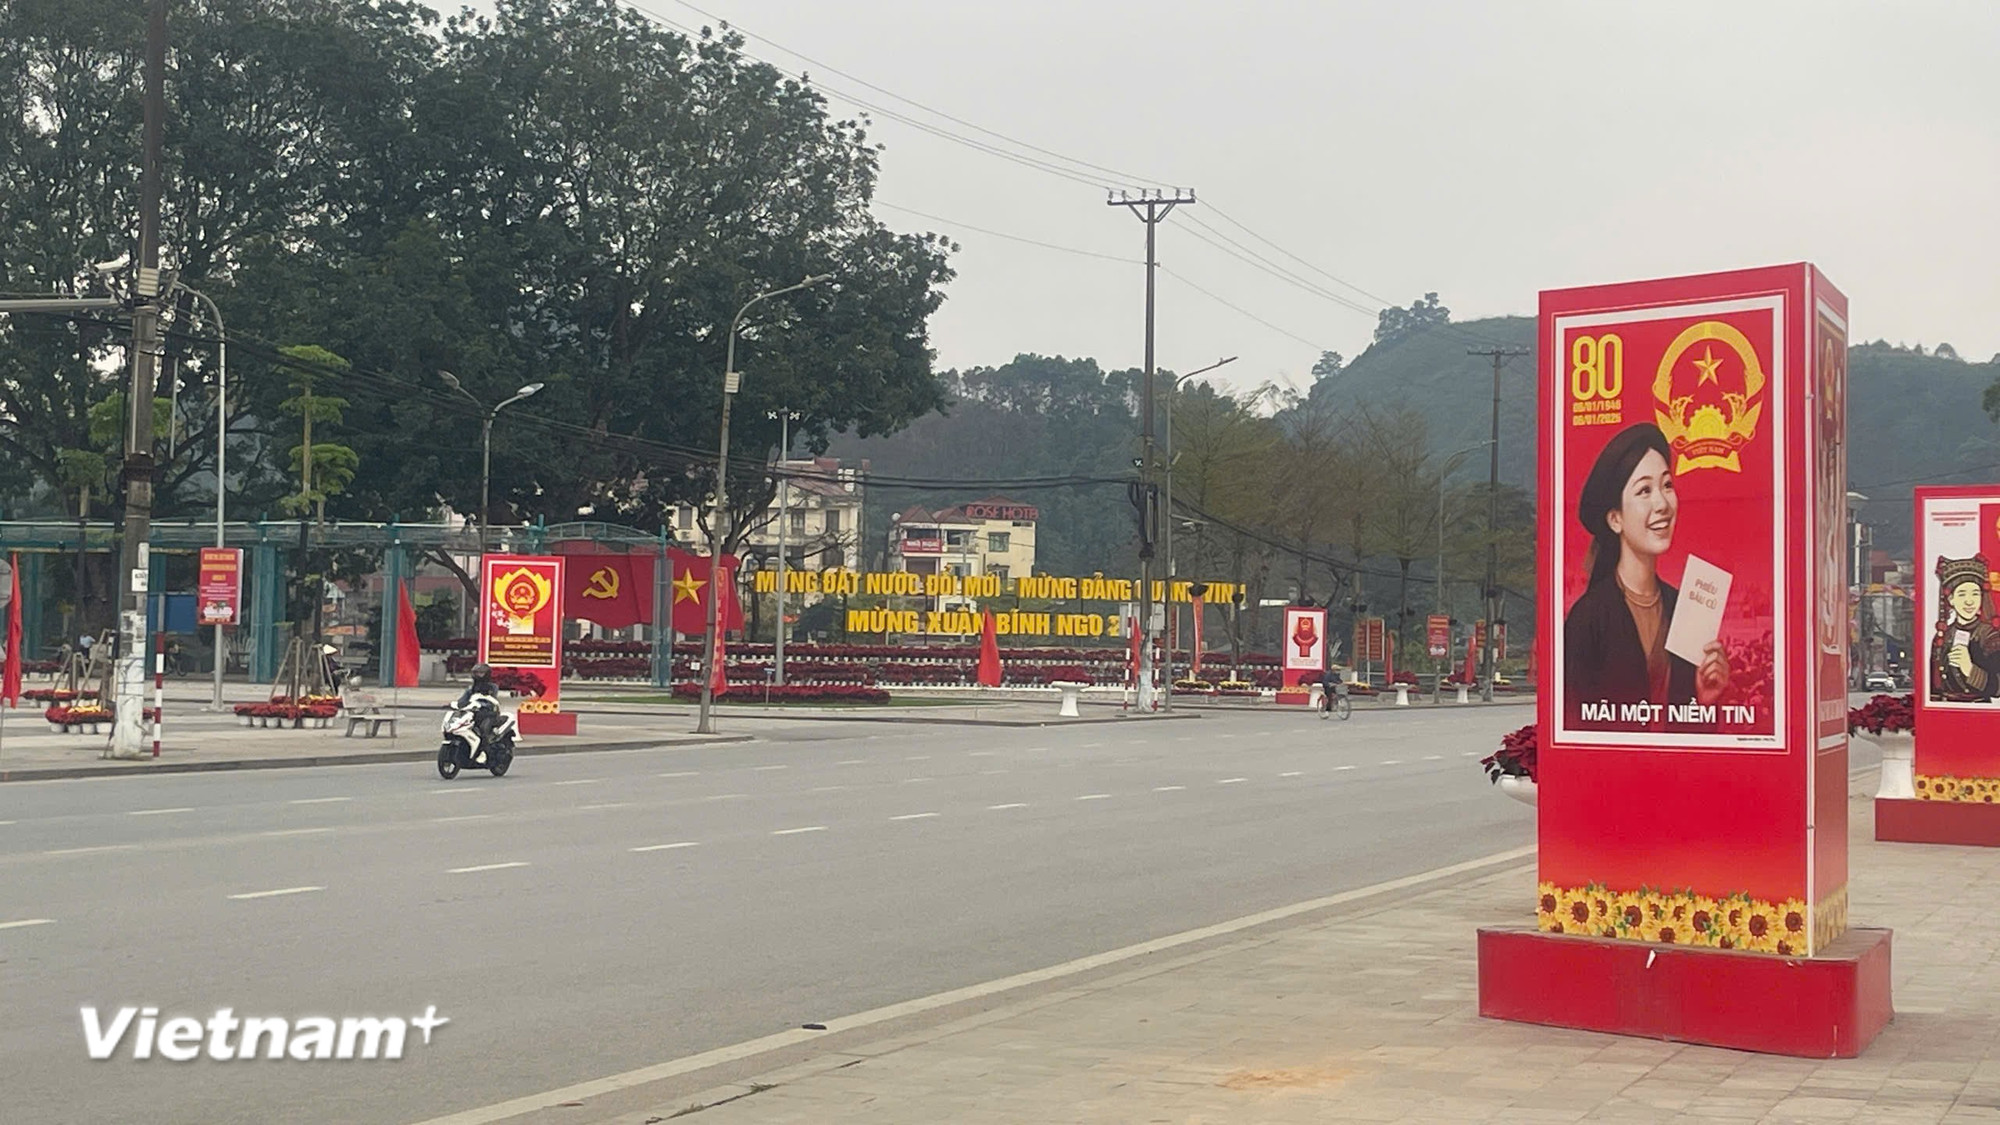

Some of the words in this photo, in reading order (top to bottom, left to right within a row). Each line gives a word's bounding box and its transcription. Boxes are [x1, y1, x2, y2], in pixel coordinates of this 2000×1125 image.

[1572, 333, 1623, 401] 80
[966, 506, 1000, 518] ROSE
[1580, 699, 1616, 722] MÃI
[1620, 699, 1664, 726] MỘT
[1667, 697, 1717, 724] NIỀM
[1721, 704, 1756, 725] TIN
